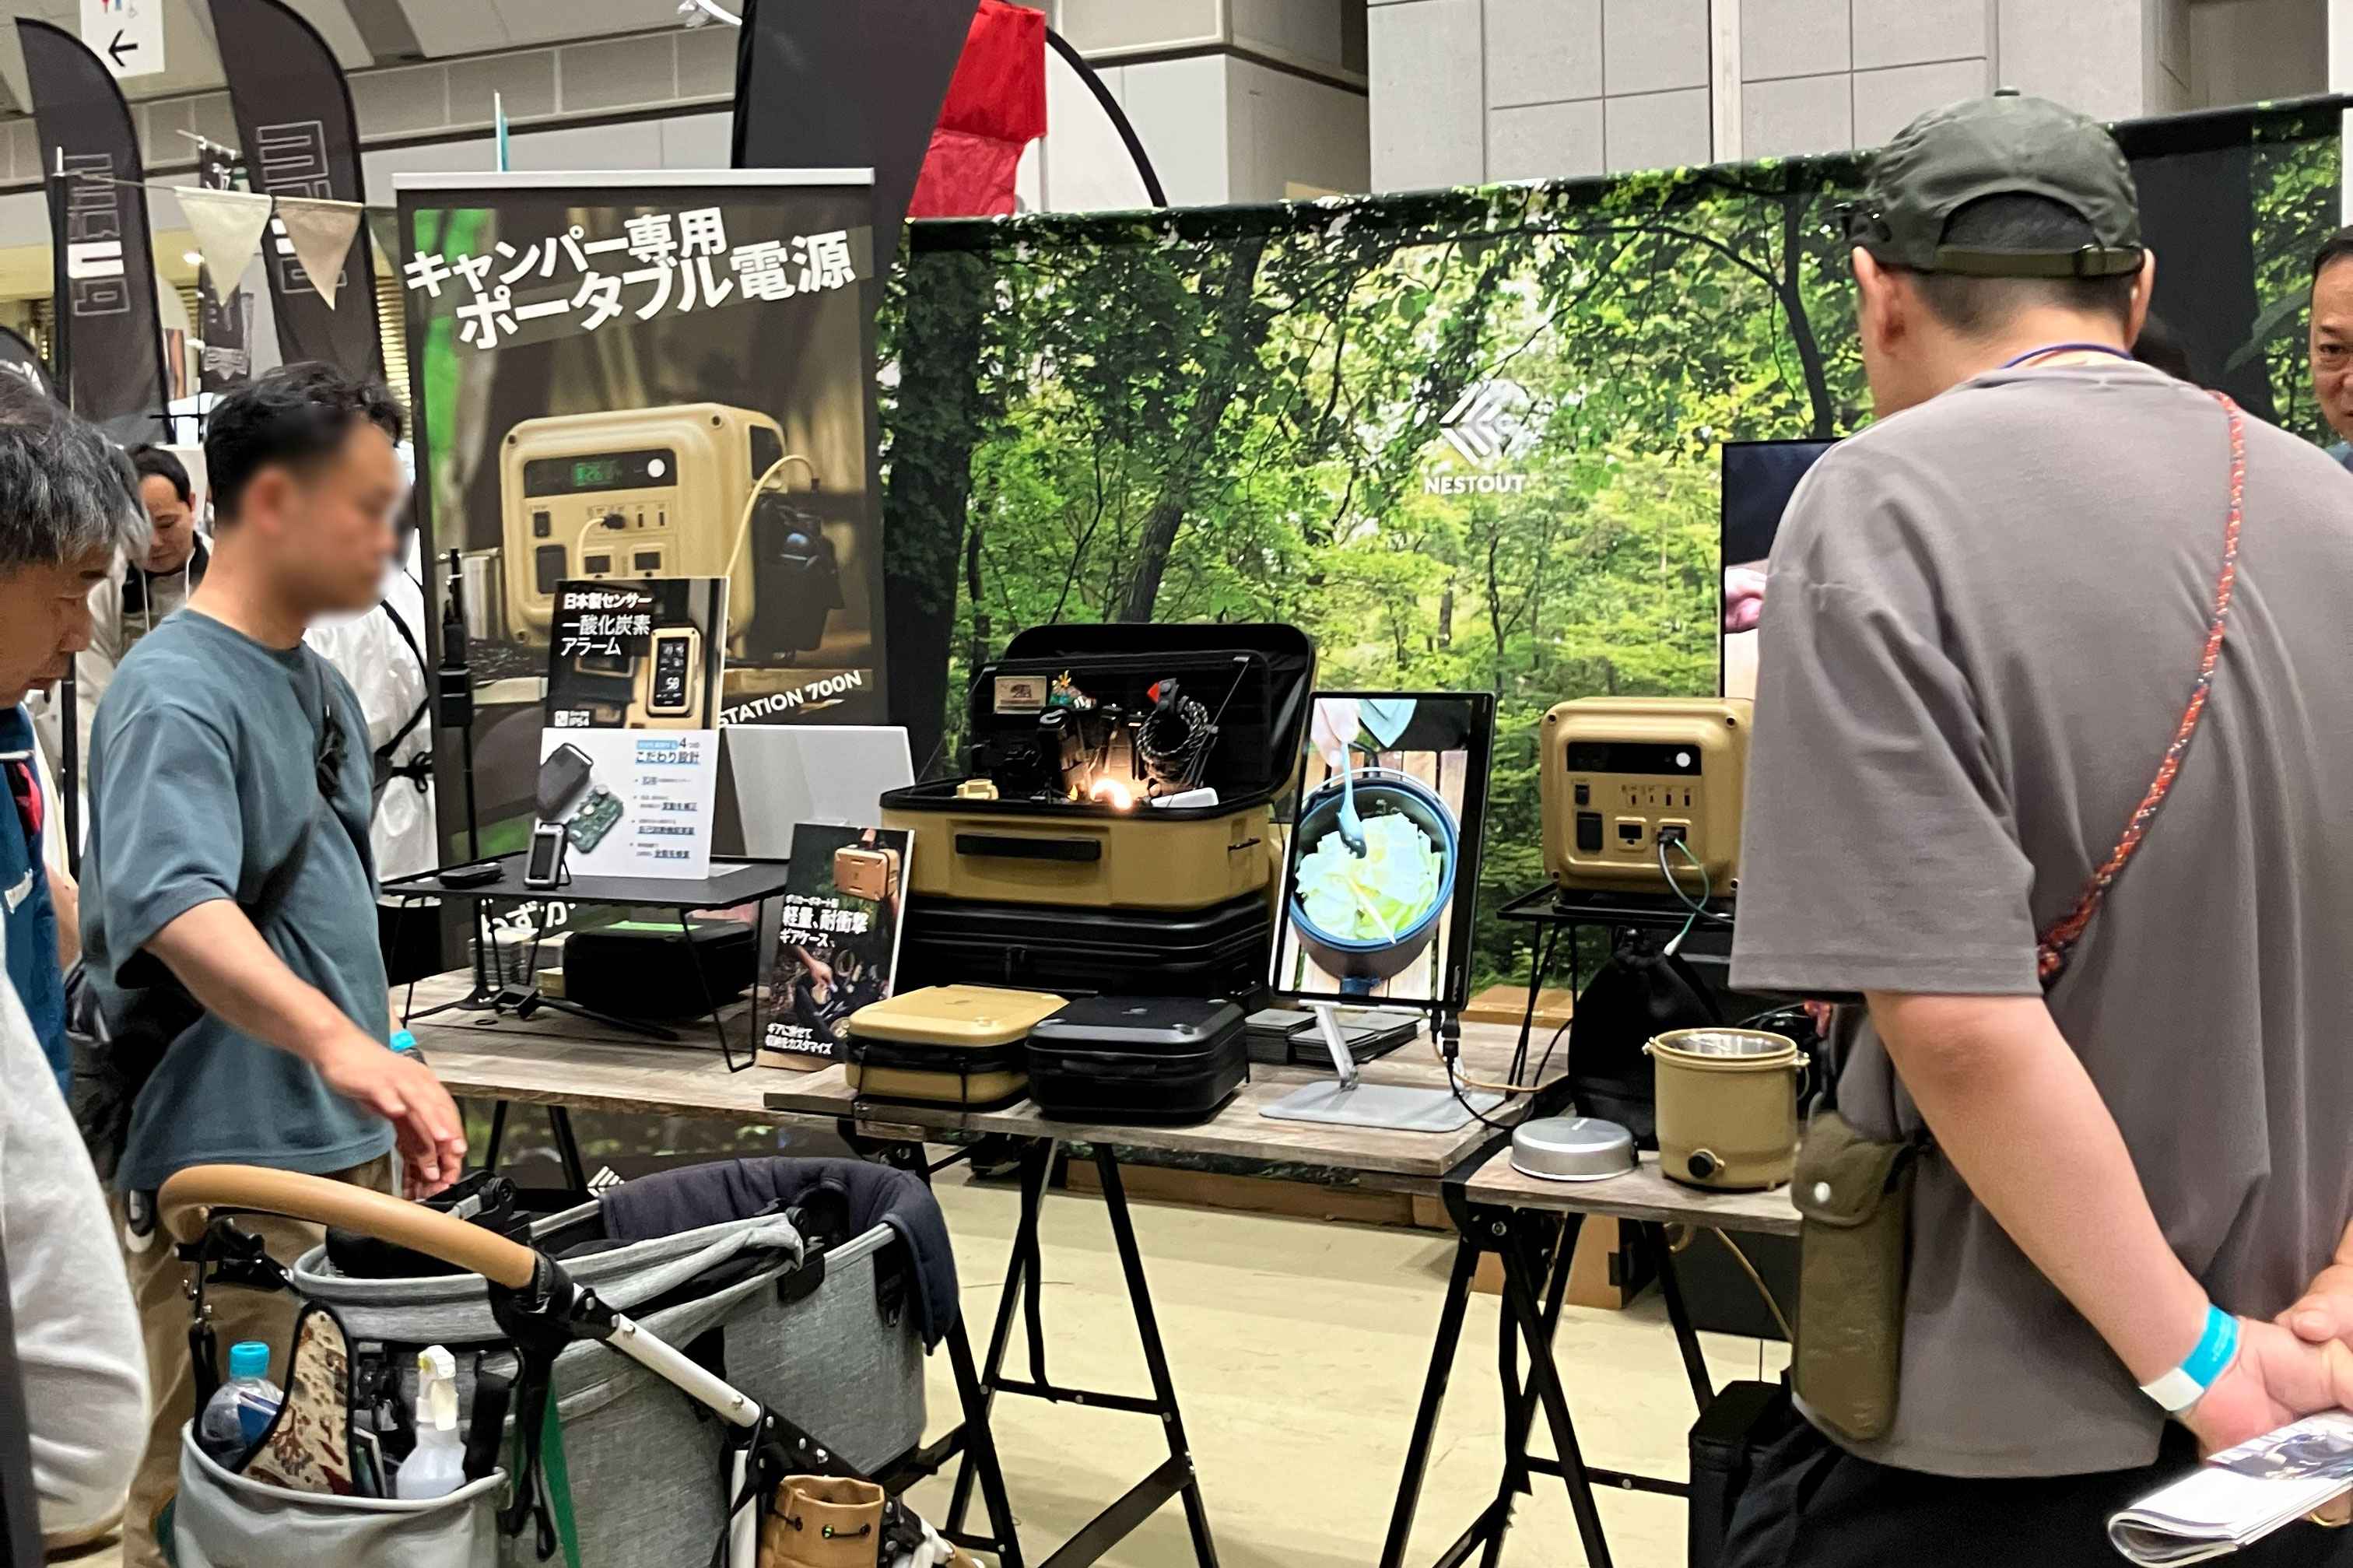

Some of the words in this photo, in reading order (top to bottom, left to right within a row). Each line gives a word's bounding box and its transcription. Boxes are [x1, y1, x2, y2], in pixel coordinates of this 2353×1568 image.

[404, 207, 728, 298] キャンパー専用
[456, 230, 856, 349] ポータブル電源
[1424, 474, 1526, 495] NESTOUT
[563, 592, 652, 610] 日本製センサー
[562, 613, 651, 637] 一酸化炭素
[560, 637, 622, 656] アラーム
[719, 688, 805, 728] STATION
[805, 669, 863, 700] 700N
[782, 904, 869, 935] 軽量、耐衝撃
